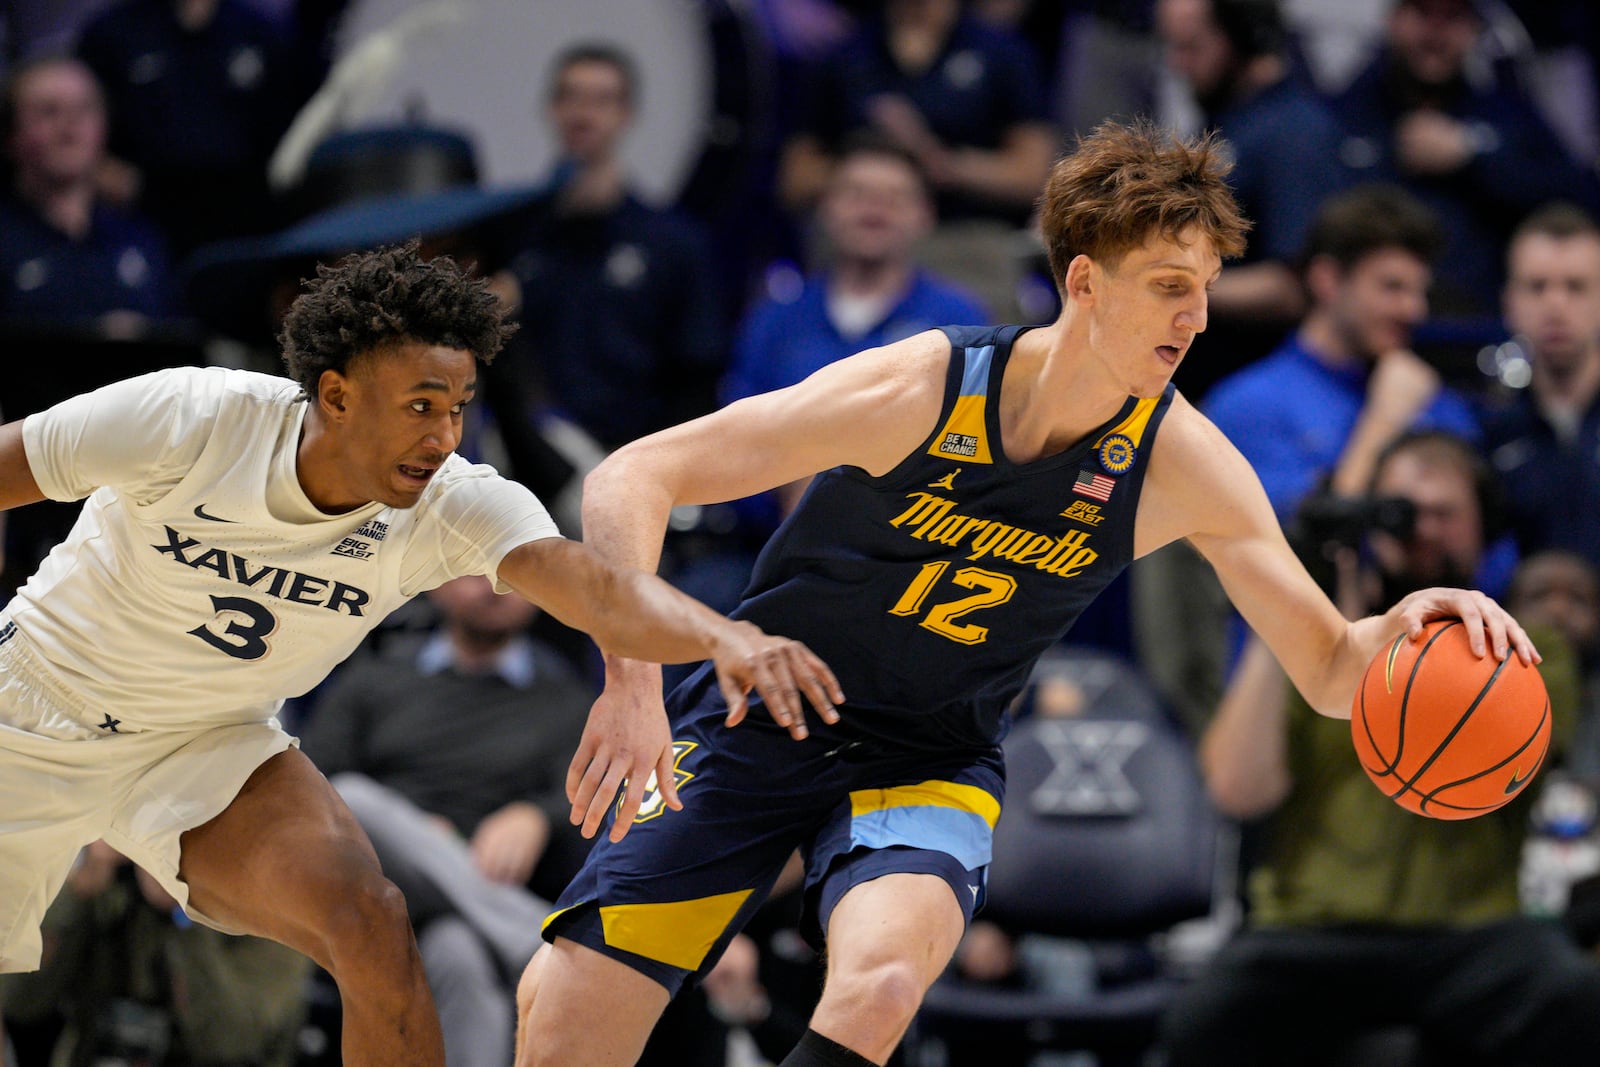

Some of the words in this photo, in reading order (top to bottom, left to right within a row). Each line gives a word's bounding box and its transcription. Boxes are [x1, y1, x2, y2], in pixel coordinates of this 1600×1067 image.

[946, 433, 961, 444] BE
[961, 436, 977, 447] THE
[940, 442, 977, 456] CHANGE
[1063, 506, 1105, 523] EAST
[1071, 500, 1102, 514] BIG
[372, 520, 388, 532] THE
[889, 491, 1099, 578] Marquette
[334, 544, 375, 558] EAST
[340, 537, 371, 550] BIG
[150, 524, 371, 617] XAVIER
[887, 560, 1018, 645] 12
[186, 594, 279, 662] 3
[97, 712, 122, 733] X
